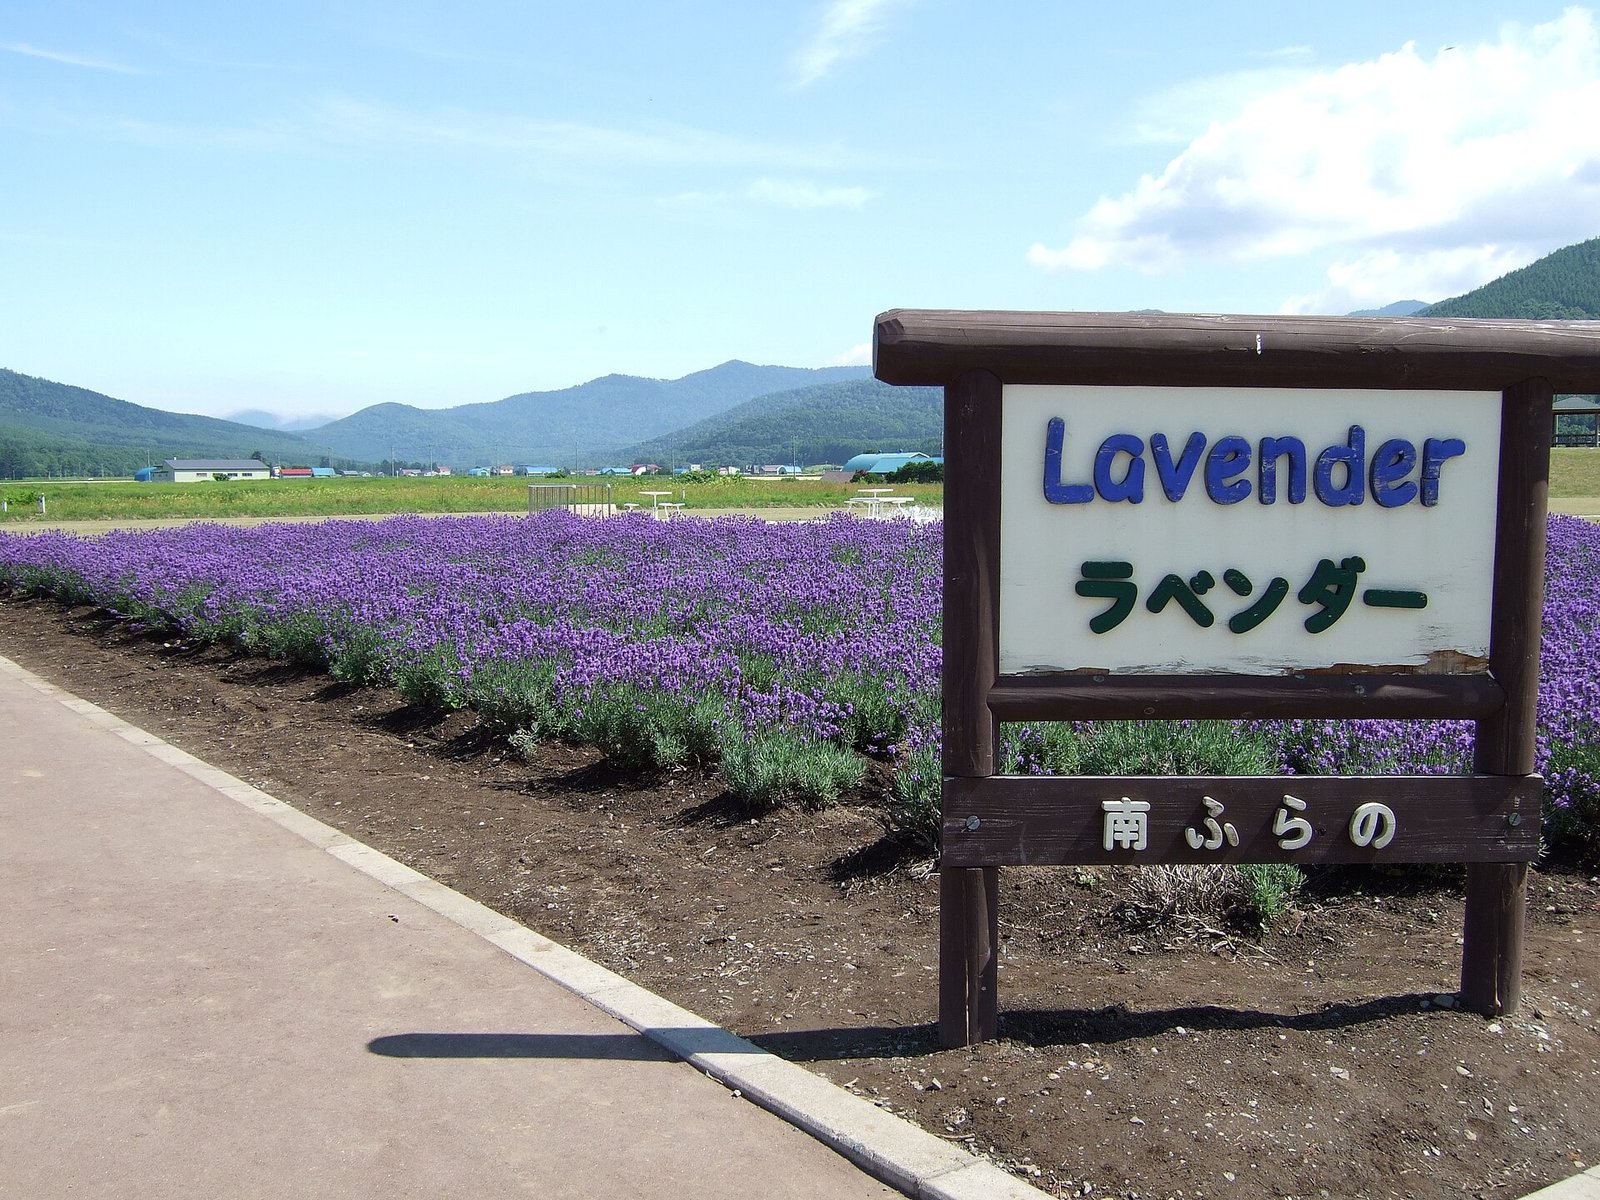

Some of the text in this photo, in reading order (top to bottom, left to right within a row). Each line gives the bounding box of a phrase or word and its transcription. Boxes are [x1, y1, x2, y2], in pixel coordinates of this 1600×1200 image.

[1043, 417, 1466, 507] Lavender
[1075, 556, 1427, 634] ラベンダー
[1101, 795, 1397, 851] 南ふらの
